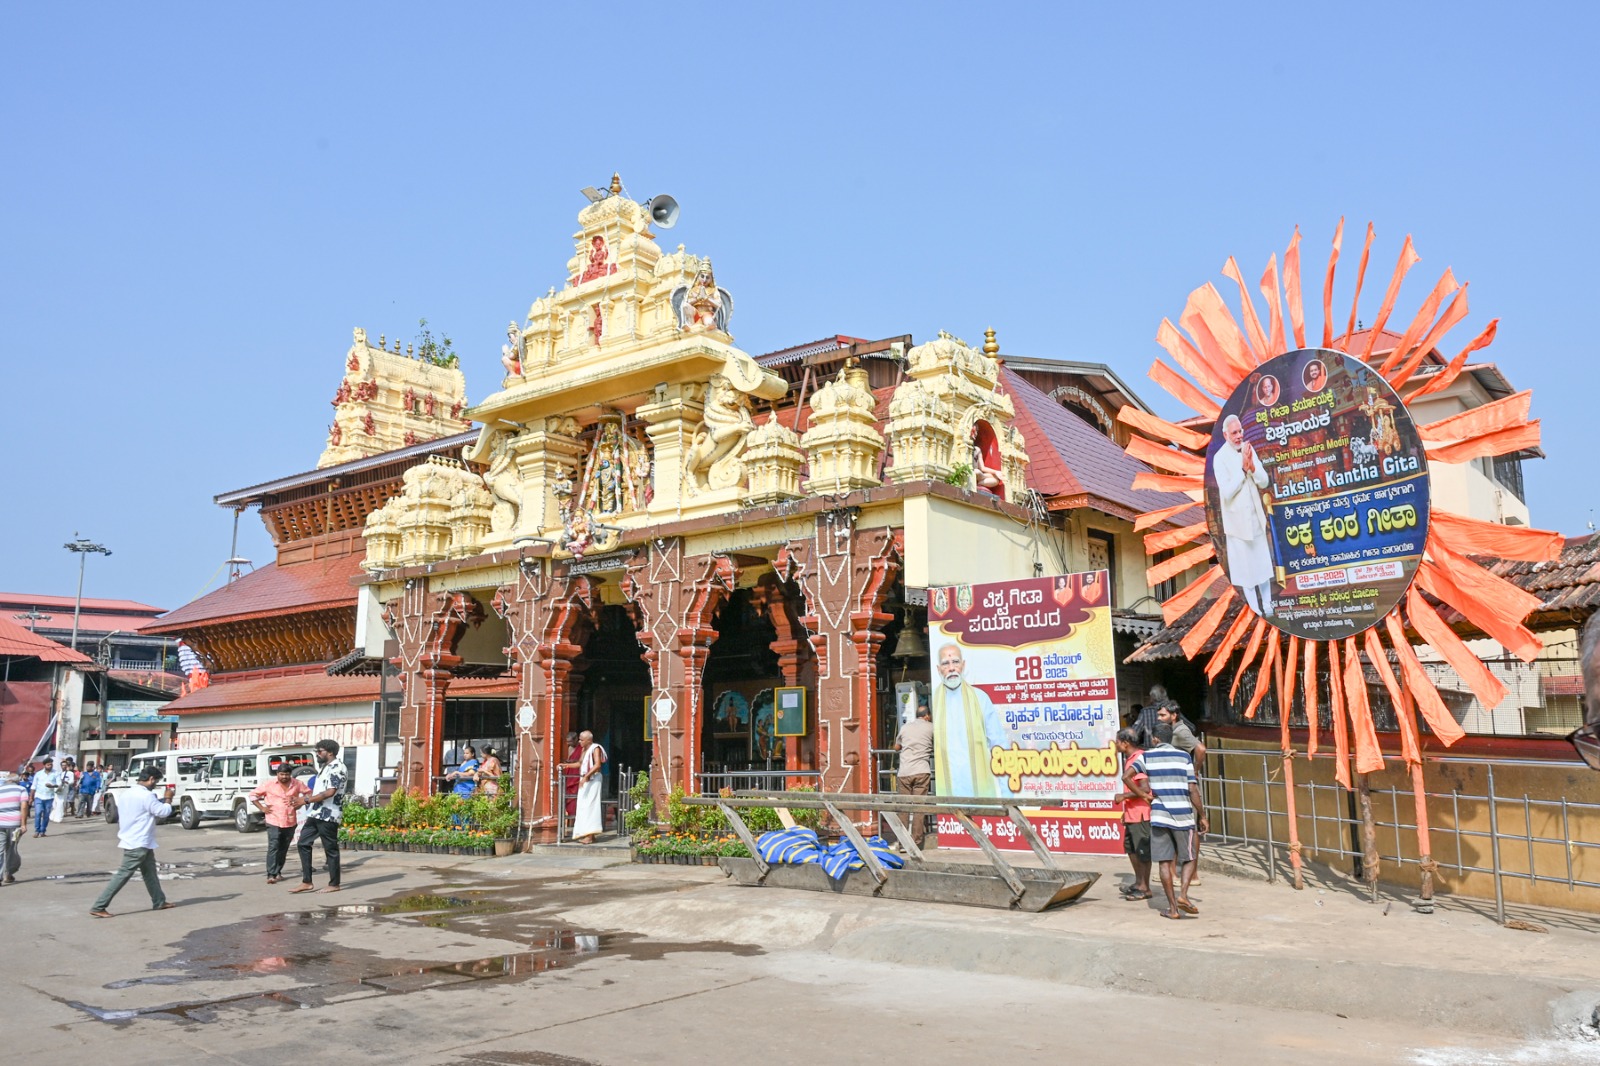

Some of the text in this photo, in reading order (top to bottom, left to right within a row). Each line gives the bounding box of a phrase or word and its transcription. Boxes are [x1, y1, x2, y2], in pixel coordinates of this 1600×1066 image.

[1270, 405, 1290, 418] ಗೀತಾ
[1266, 409, 1331, 446] ವಿಶ್ವನಾಯಕ
[1275, 451, 1290, 463] Shri
[1291, 443, 1325, 458] Narendra
[1326, 435, 1349, 450] Modiji
[1273, 455, 1419, 499] Laksha Kantha Gita
[1320, 507, 1360, 541] ಕಂಠ
[1367, 503, 1417, 535] ಗೀತಾ
[1298, 570, 1345, 584] 28-11-2025
[968, 608, 1061, 633] ಪರ್ಯಾಯದ
[1015, 653, 1082, 681] 28 ನವೆಂಬರ್
[1045, 667, 1068, 679] 2025
[1005, 707, 1040, 730] ಬೃಹತ್
[1044, 703, 1104, 726] ಗೀತೋತ್ಸವ
[991, 740, 1119, 793] ವಿಶ್ವನಾಯಕರಾದ
[1040, 820, 1060, 847] ಕೃಷ್ಣ
[1088, 821, 1120, 840] ಉಡುಪಿ
